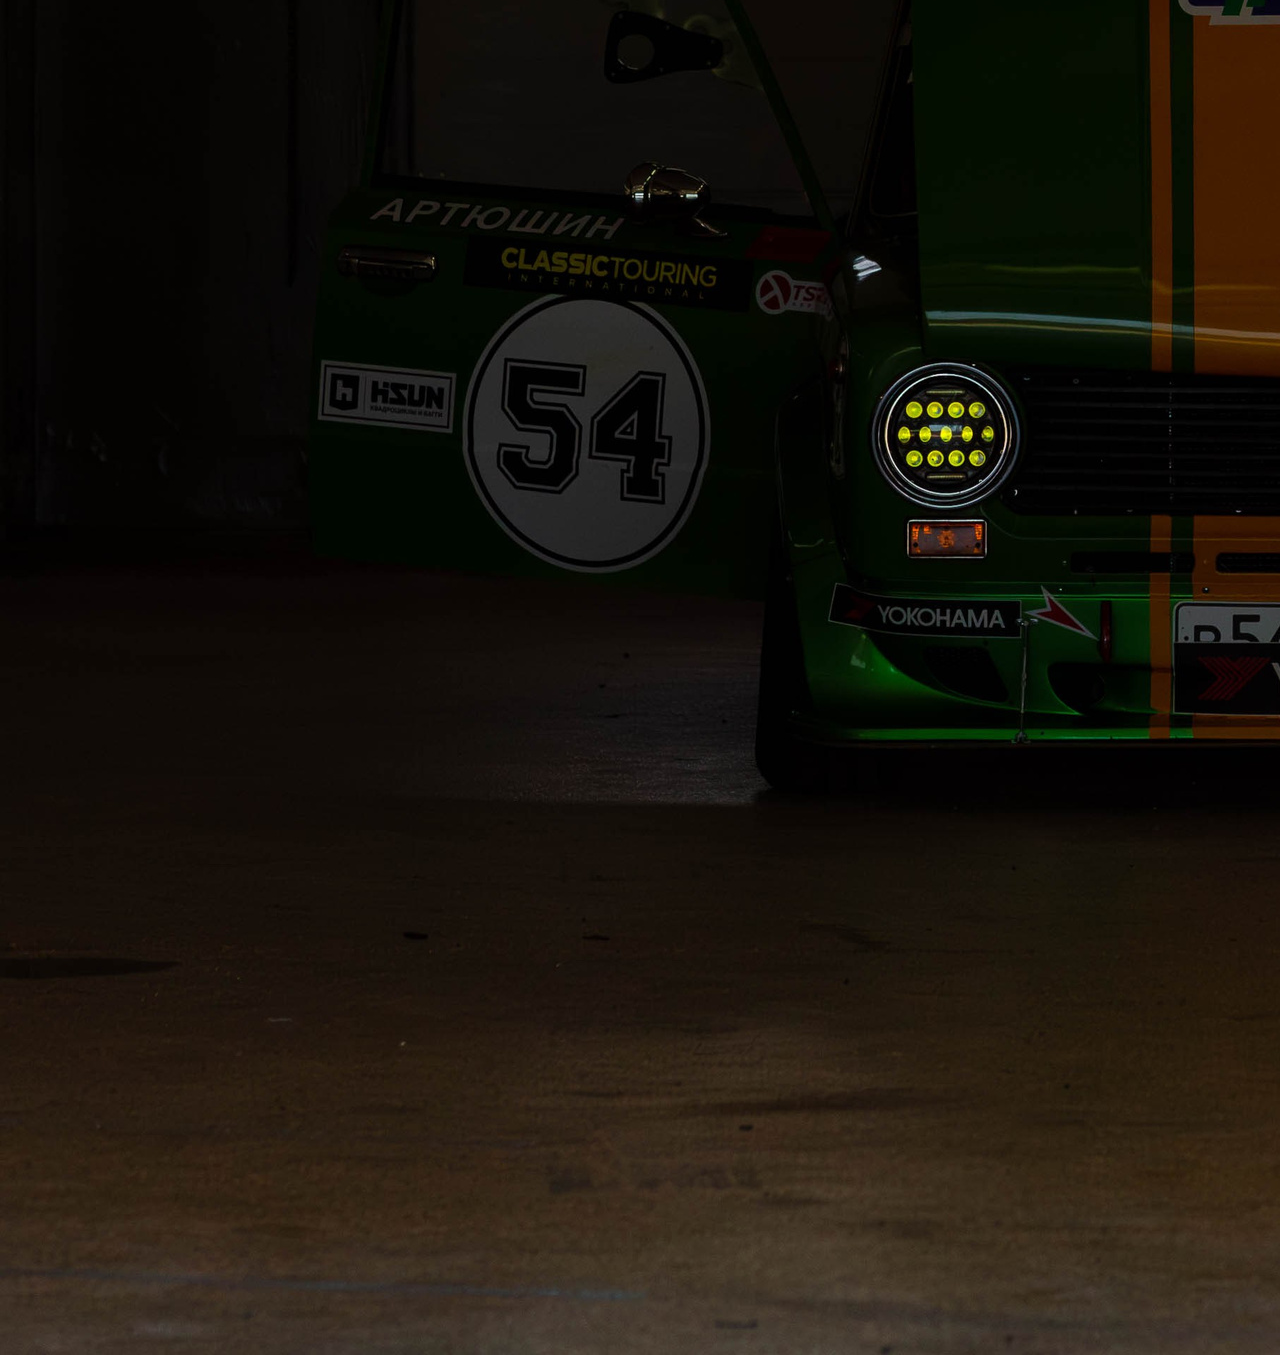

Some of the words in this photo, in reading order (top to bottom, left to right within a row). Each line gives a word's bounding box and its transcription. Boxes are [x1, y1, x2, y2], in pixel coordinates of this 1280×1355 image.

[369, 197, 626, 241] АРТЮШИН
[506, 272, 705, 301] INTERNATIONAL
[371, 380, 445, 410] HSUN
[497, 358, 672, 504] 54
[876, 605, 1006, 630] YOKOHAMA
